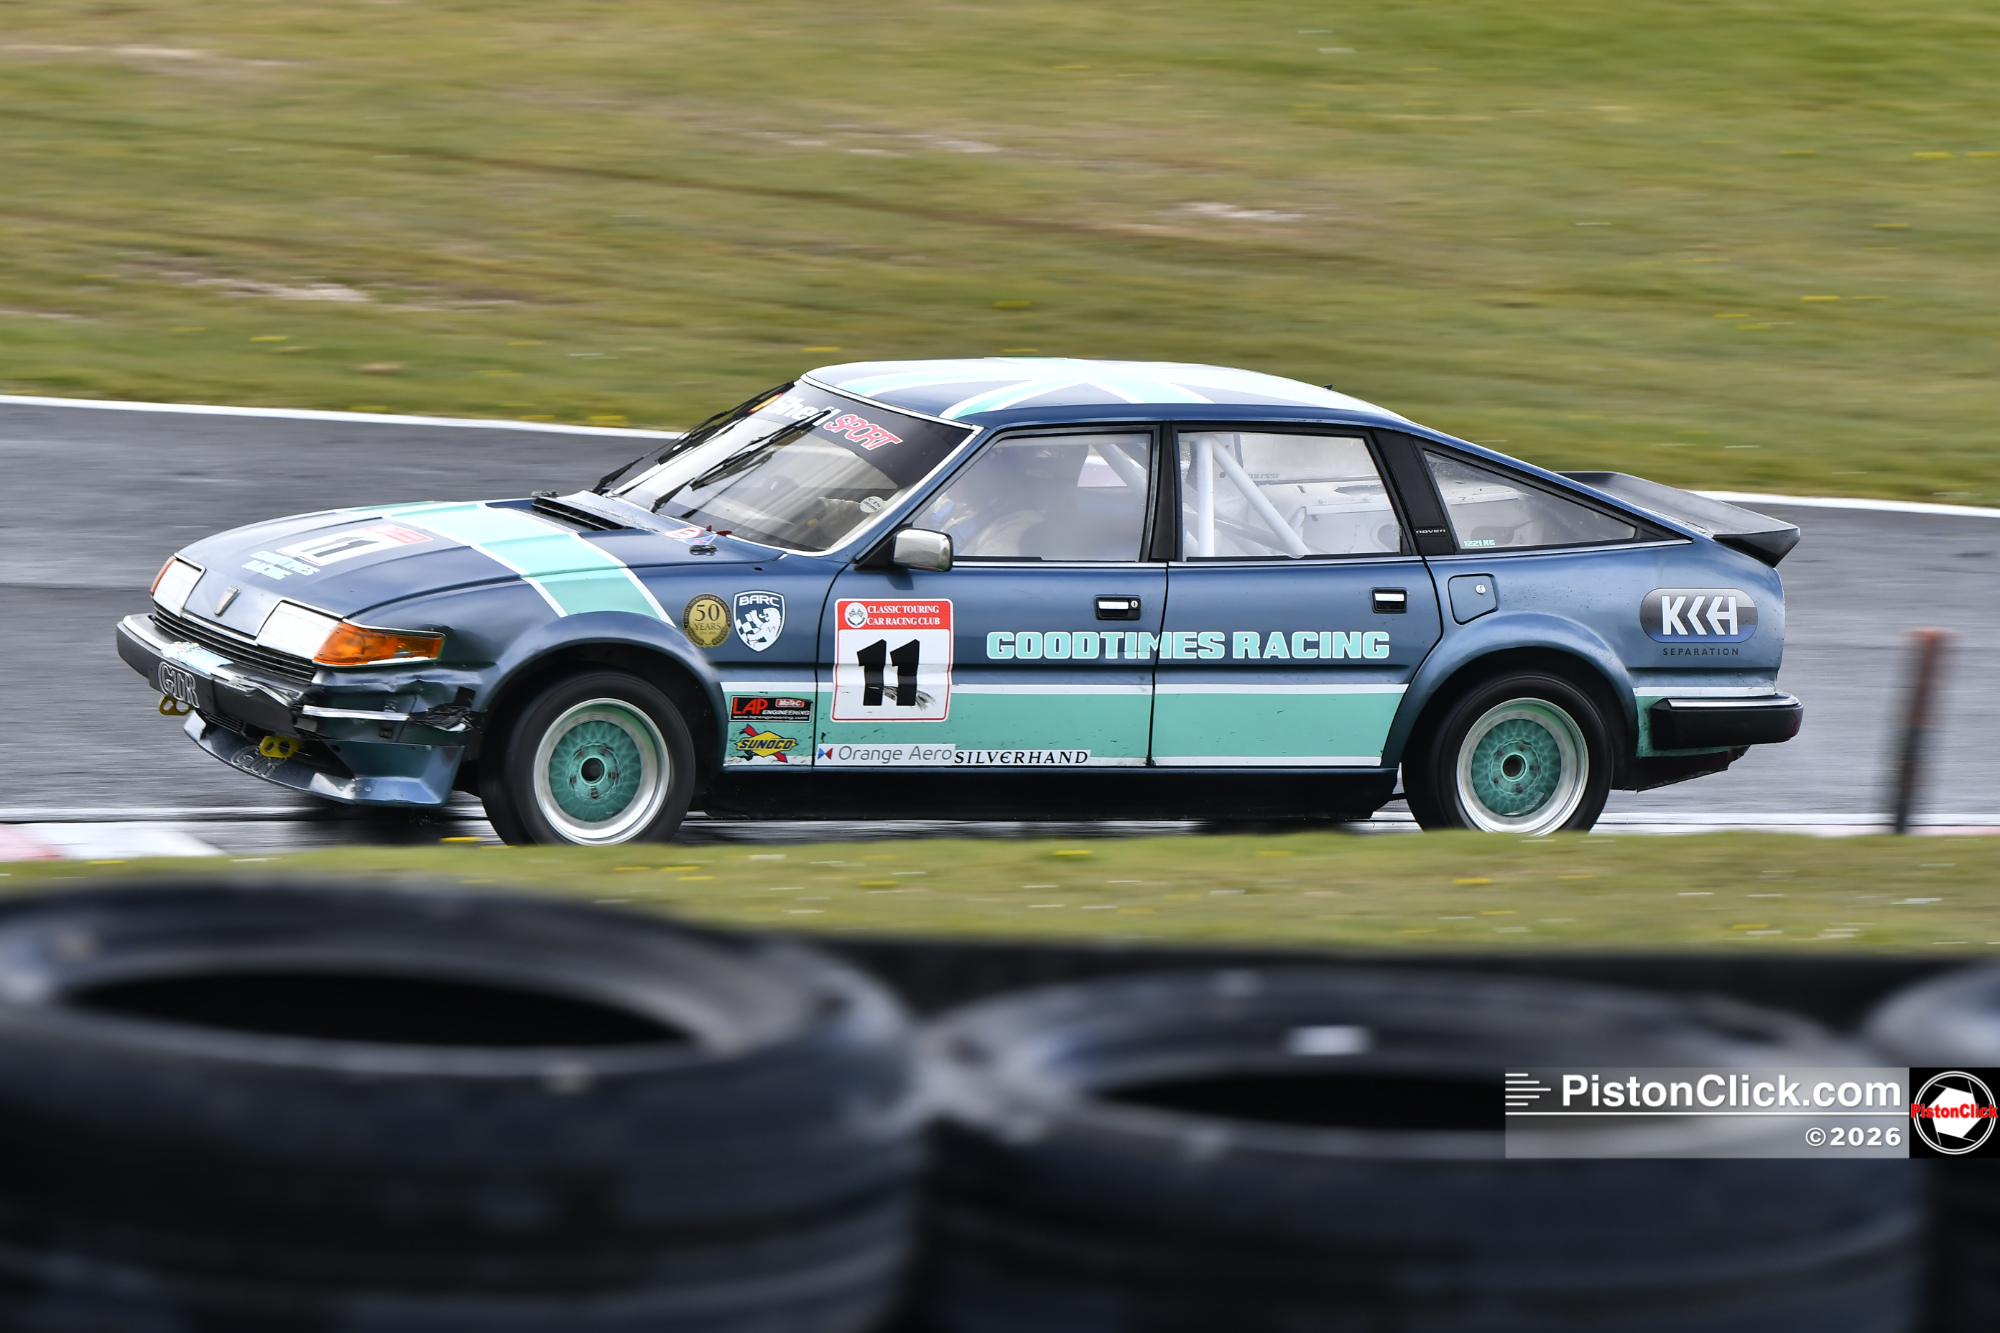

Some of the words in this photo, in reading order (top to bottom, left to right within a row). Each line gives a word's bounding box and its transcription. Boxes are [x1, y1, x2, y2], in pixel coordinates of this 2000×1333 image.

[823, 413, 904, 451] SPORT
[738, 594, 780, 607] BARC
[694, 603, 720, 622] 50
[867, 605, 901, 614] CLASSIC
[902, 605, 939, 613] TOURING
[694, 622, 722, 631] YEARS
[867, 617, 884, 626] CAR
[885, 617, 917, 625] RACING
[918, 617, 940, 625] CLUB
[986, 631, 1226, 660] GOODTIMES
[1232, 631, 1390, 660] RACING
[1662, 647, 1740, 656] SEPARATION
[856, 638, 921, 706] 11
[732, 697, 769, 715] LAP
[739, 739, 794, 750] SUNOCO
[838, 745, 902, 764] Orange
[908, 746, 953, 760] Aero
[954, 750, 1089, 764] SILVERHAND
